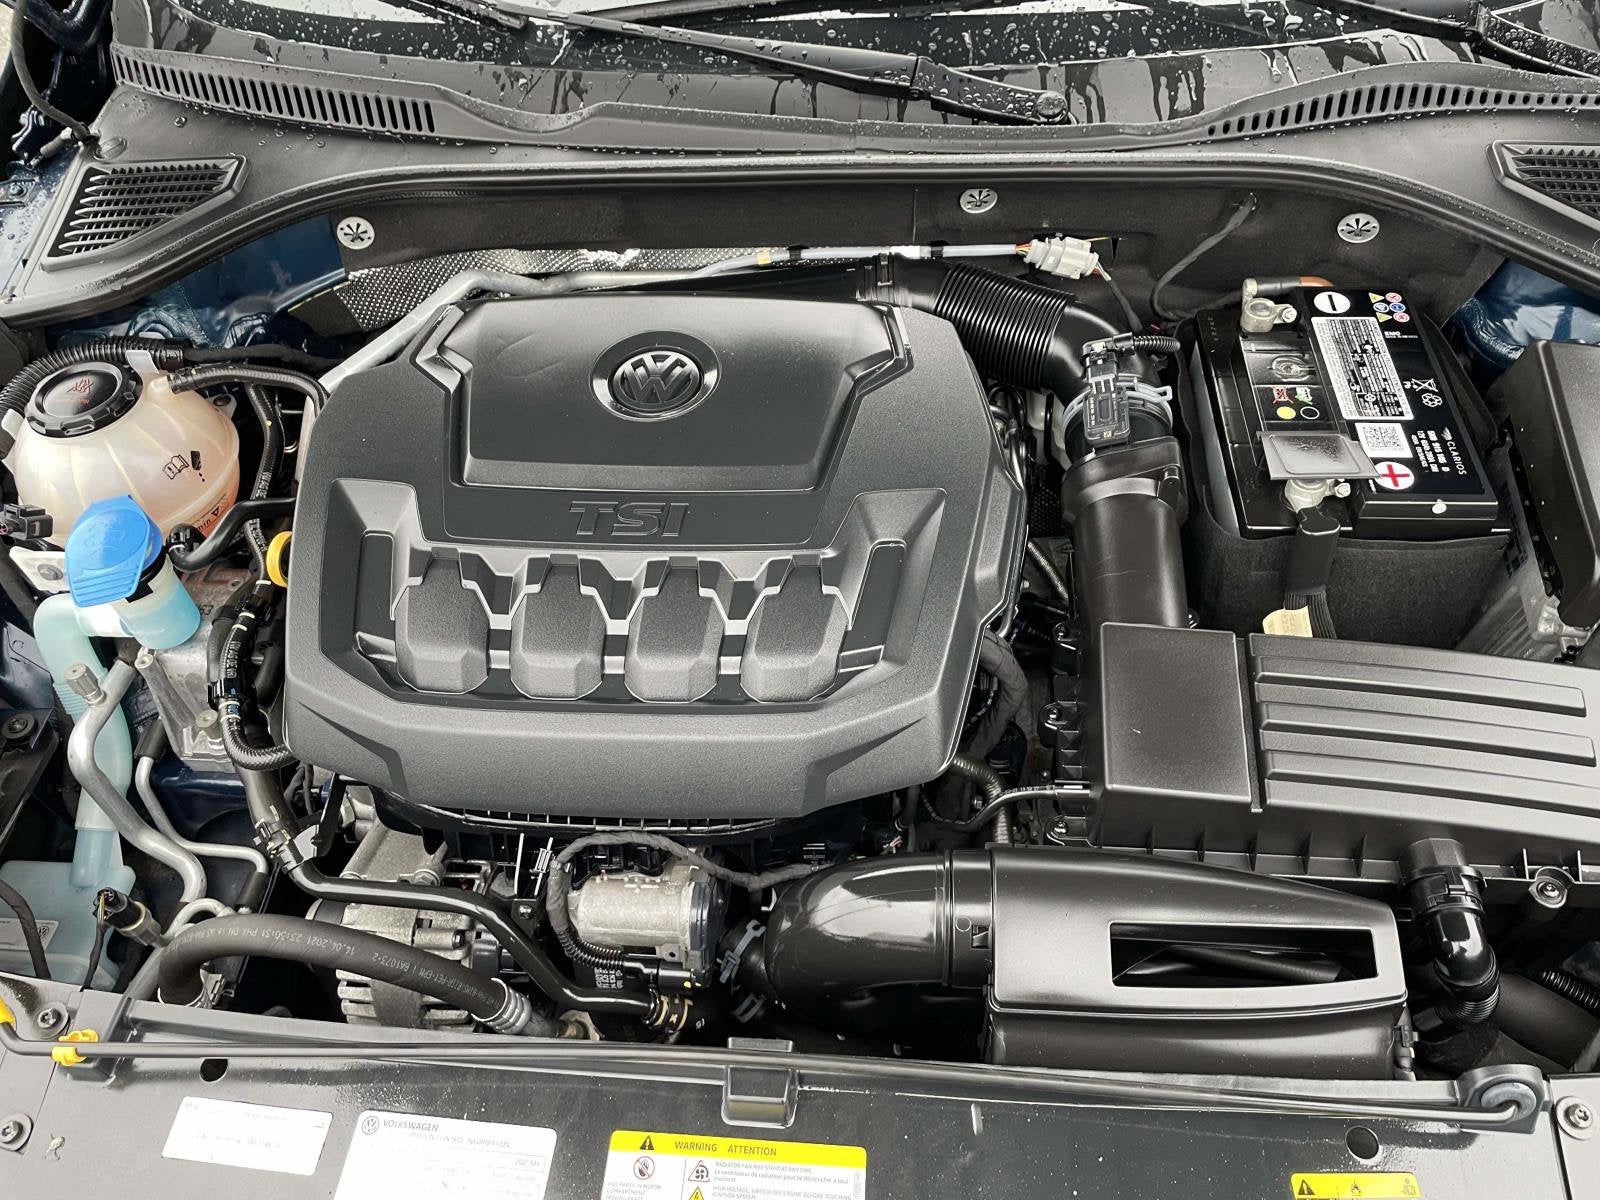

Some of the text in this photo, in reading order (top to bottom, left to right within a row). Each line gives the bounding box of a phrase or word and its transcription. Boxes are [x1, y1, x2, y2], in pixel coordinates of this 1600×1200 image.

[1447, 441, 1467, 475] CLARIOS
[569, 500, 690, 539] TSI
[383, 1119, 439, 1132] VOLKSWAGEN
[675, 1141, 777, 1156] WARNING ATTENTION
